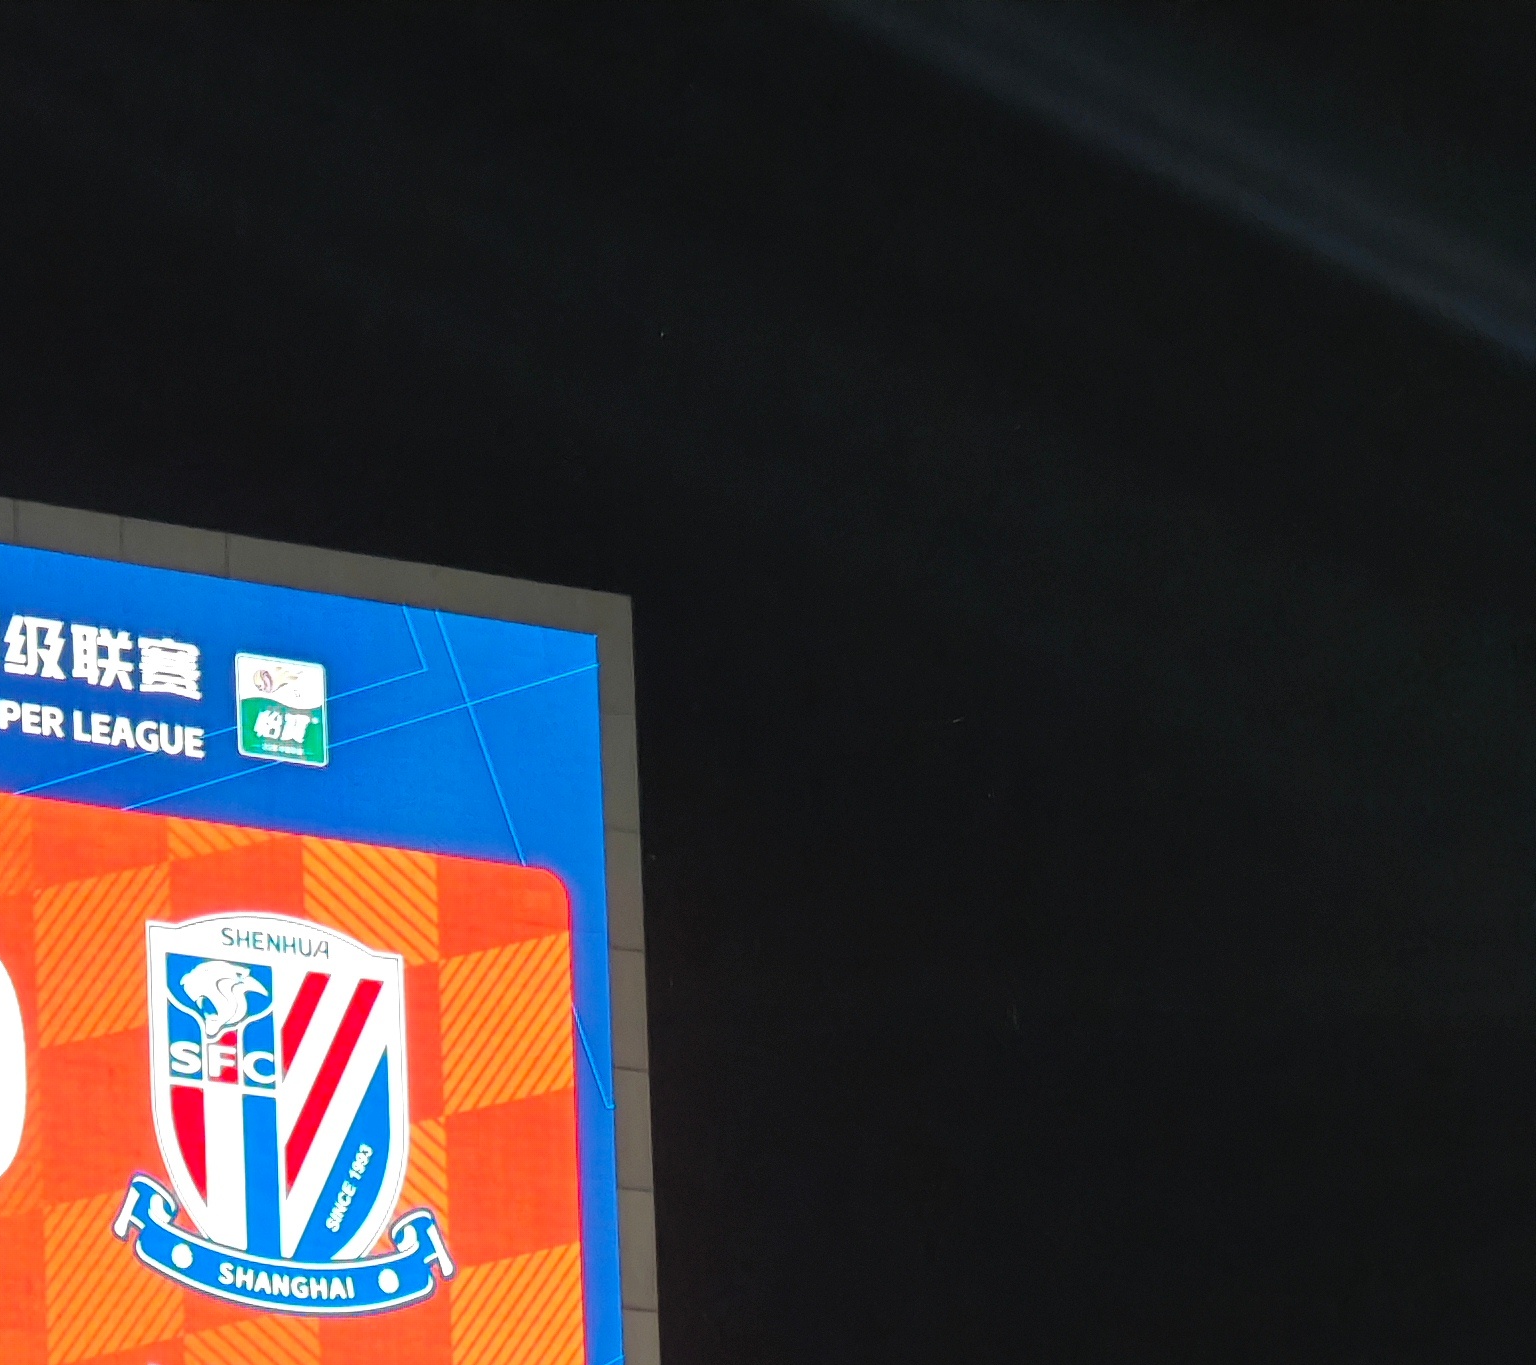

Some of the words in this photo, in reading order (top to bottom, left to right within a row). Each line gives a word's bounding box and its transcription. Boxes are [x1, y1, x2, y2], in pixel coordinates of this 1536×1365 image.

[73, 709, 204, 758] LEAGUE
[221, 928, 329, 959] SHENHUA
[169, 1041, 277, 1085] SFC
[325, 1181, 358, 1232] SINCE
[218, 1263, 355, 1300] SHANGHAI
